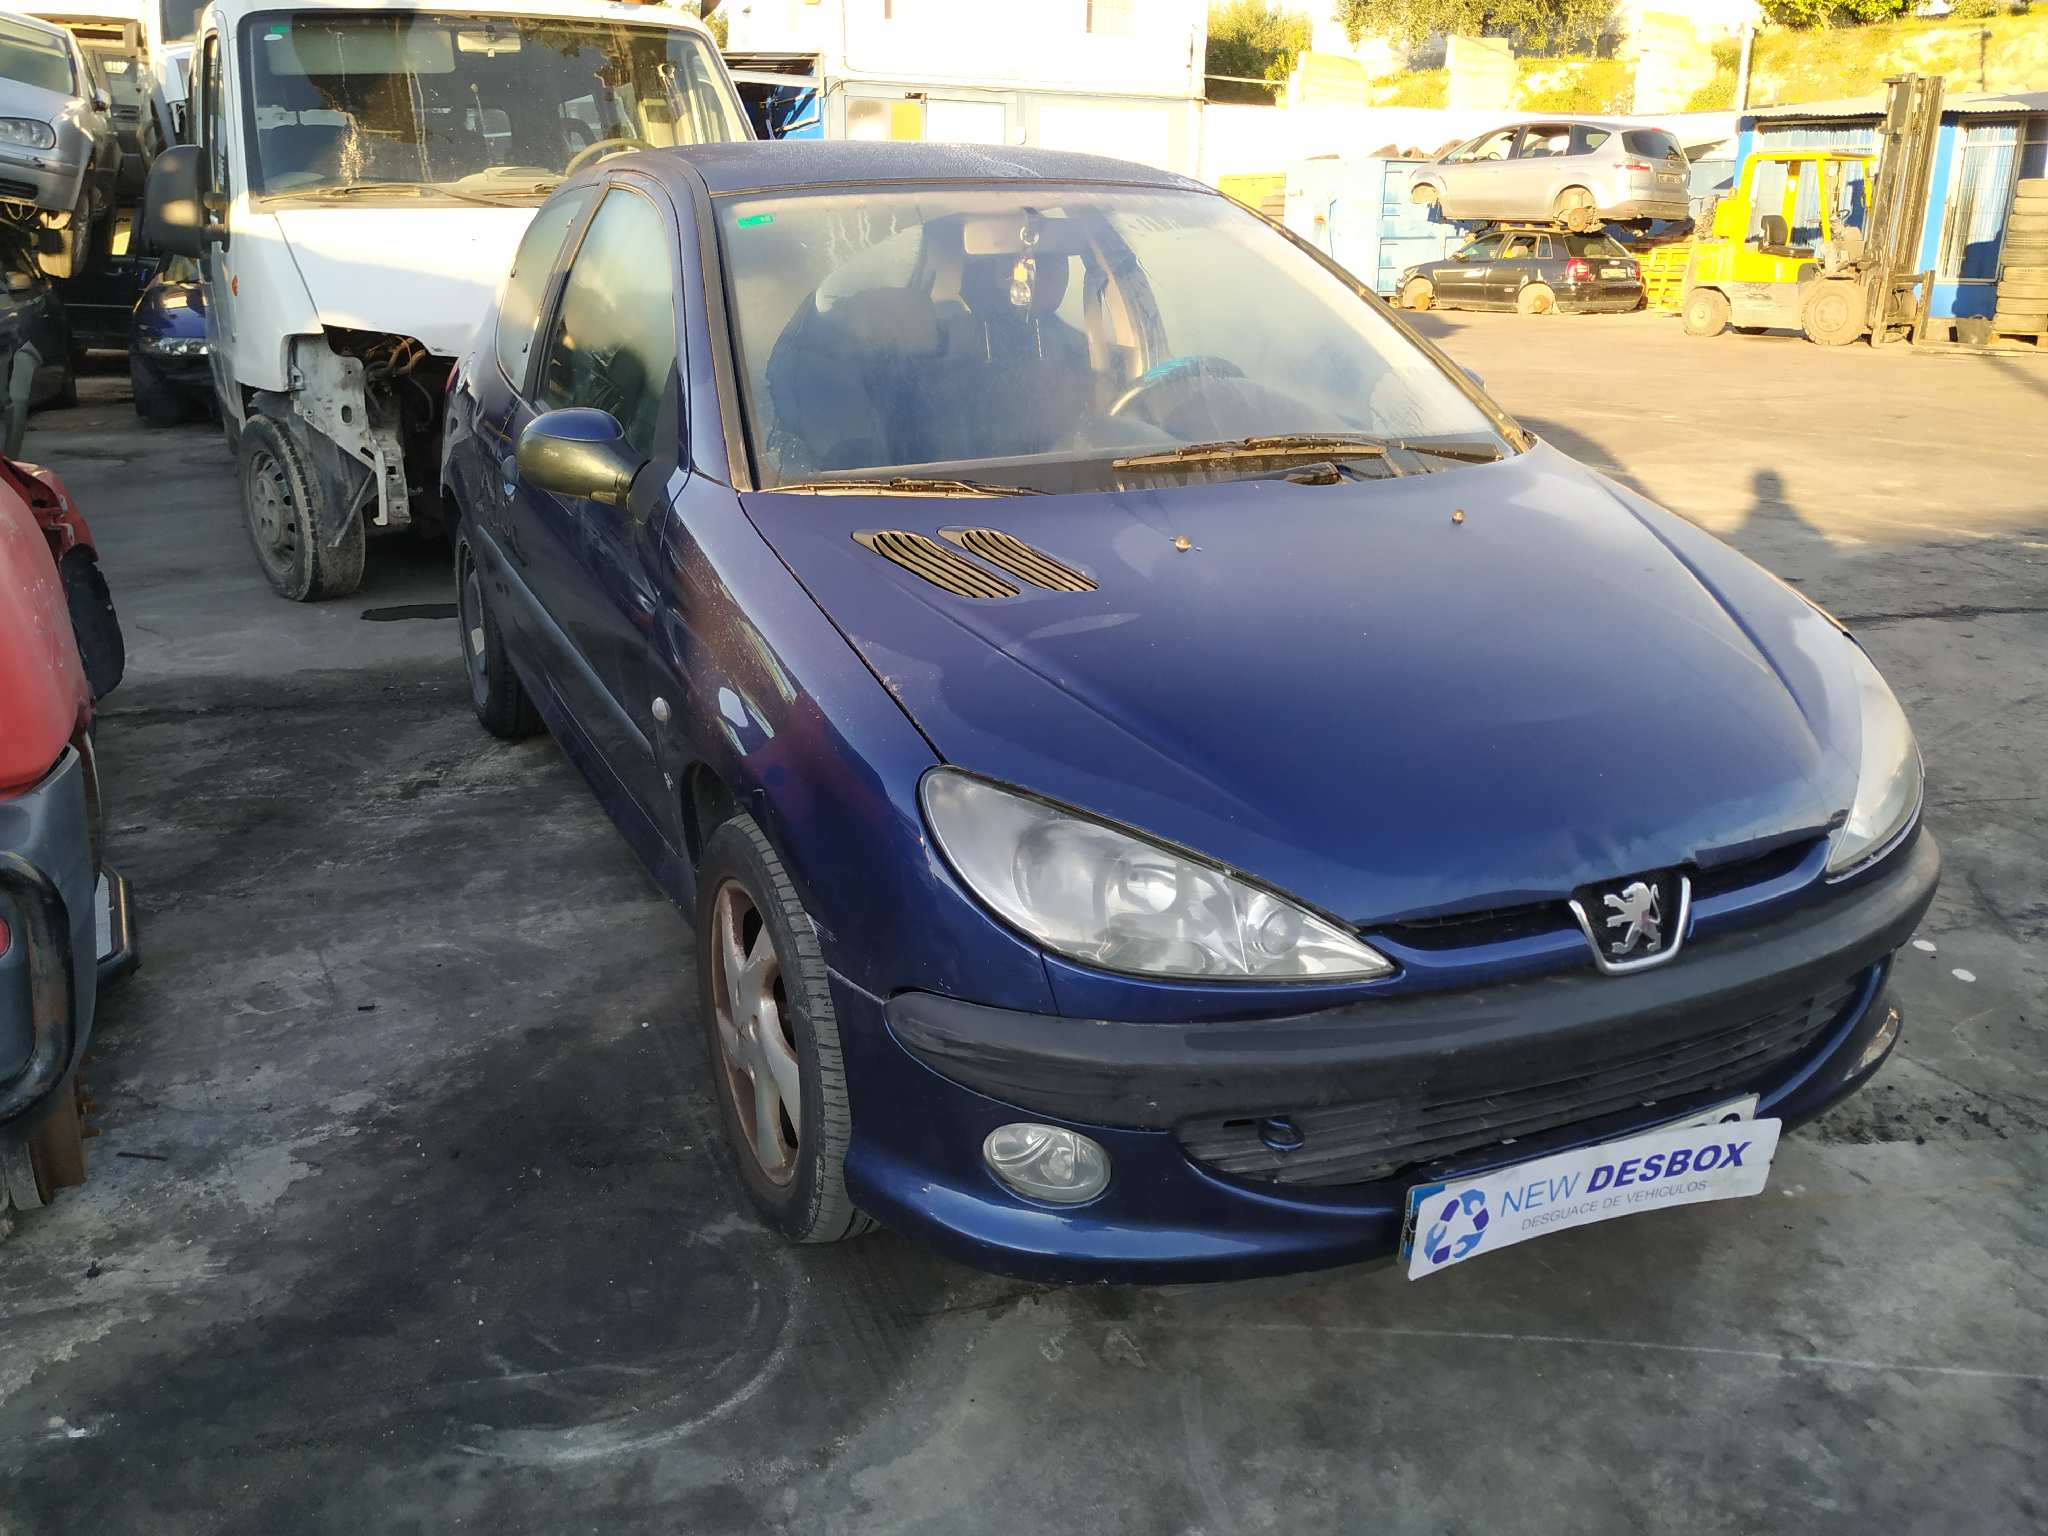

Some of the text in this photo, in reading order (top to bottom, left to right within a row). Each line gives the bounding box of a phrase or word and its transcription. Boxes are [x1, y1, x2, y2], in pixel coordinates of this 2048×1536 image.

[1500, 1141, 1752, 1218] NEW DESBOX
[1521, 1179, 1708, 1230] DESGUACE DE VEHICULOS
